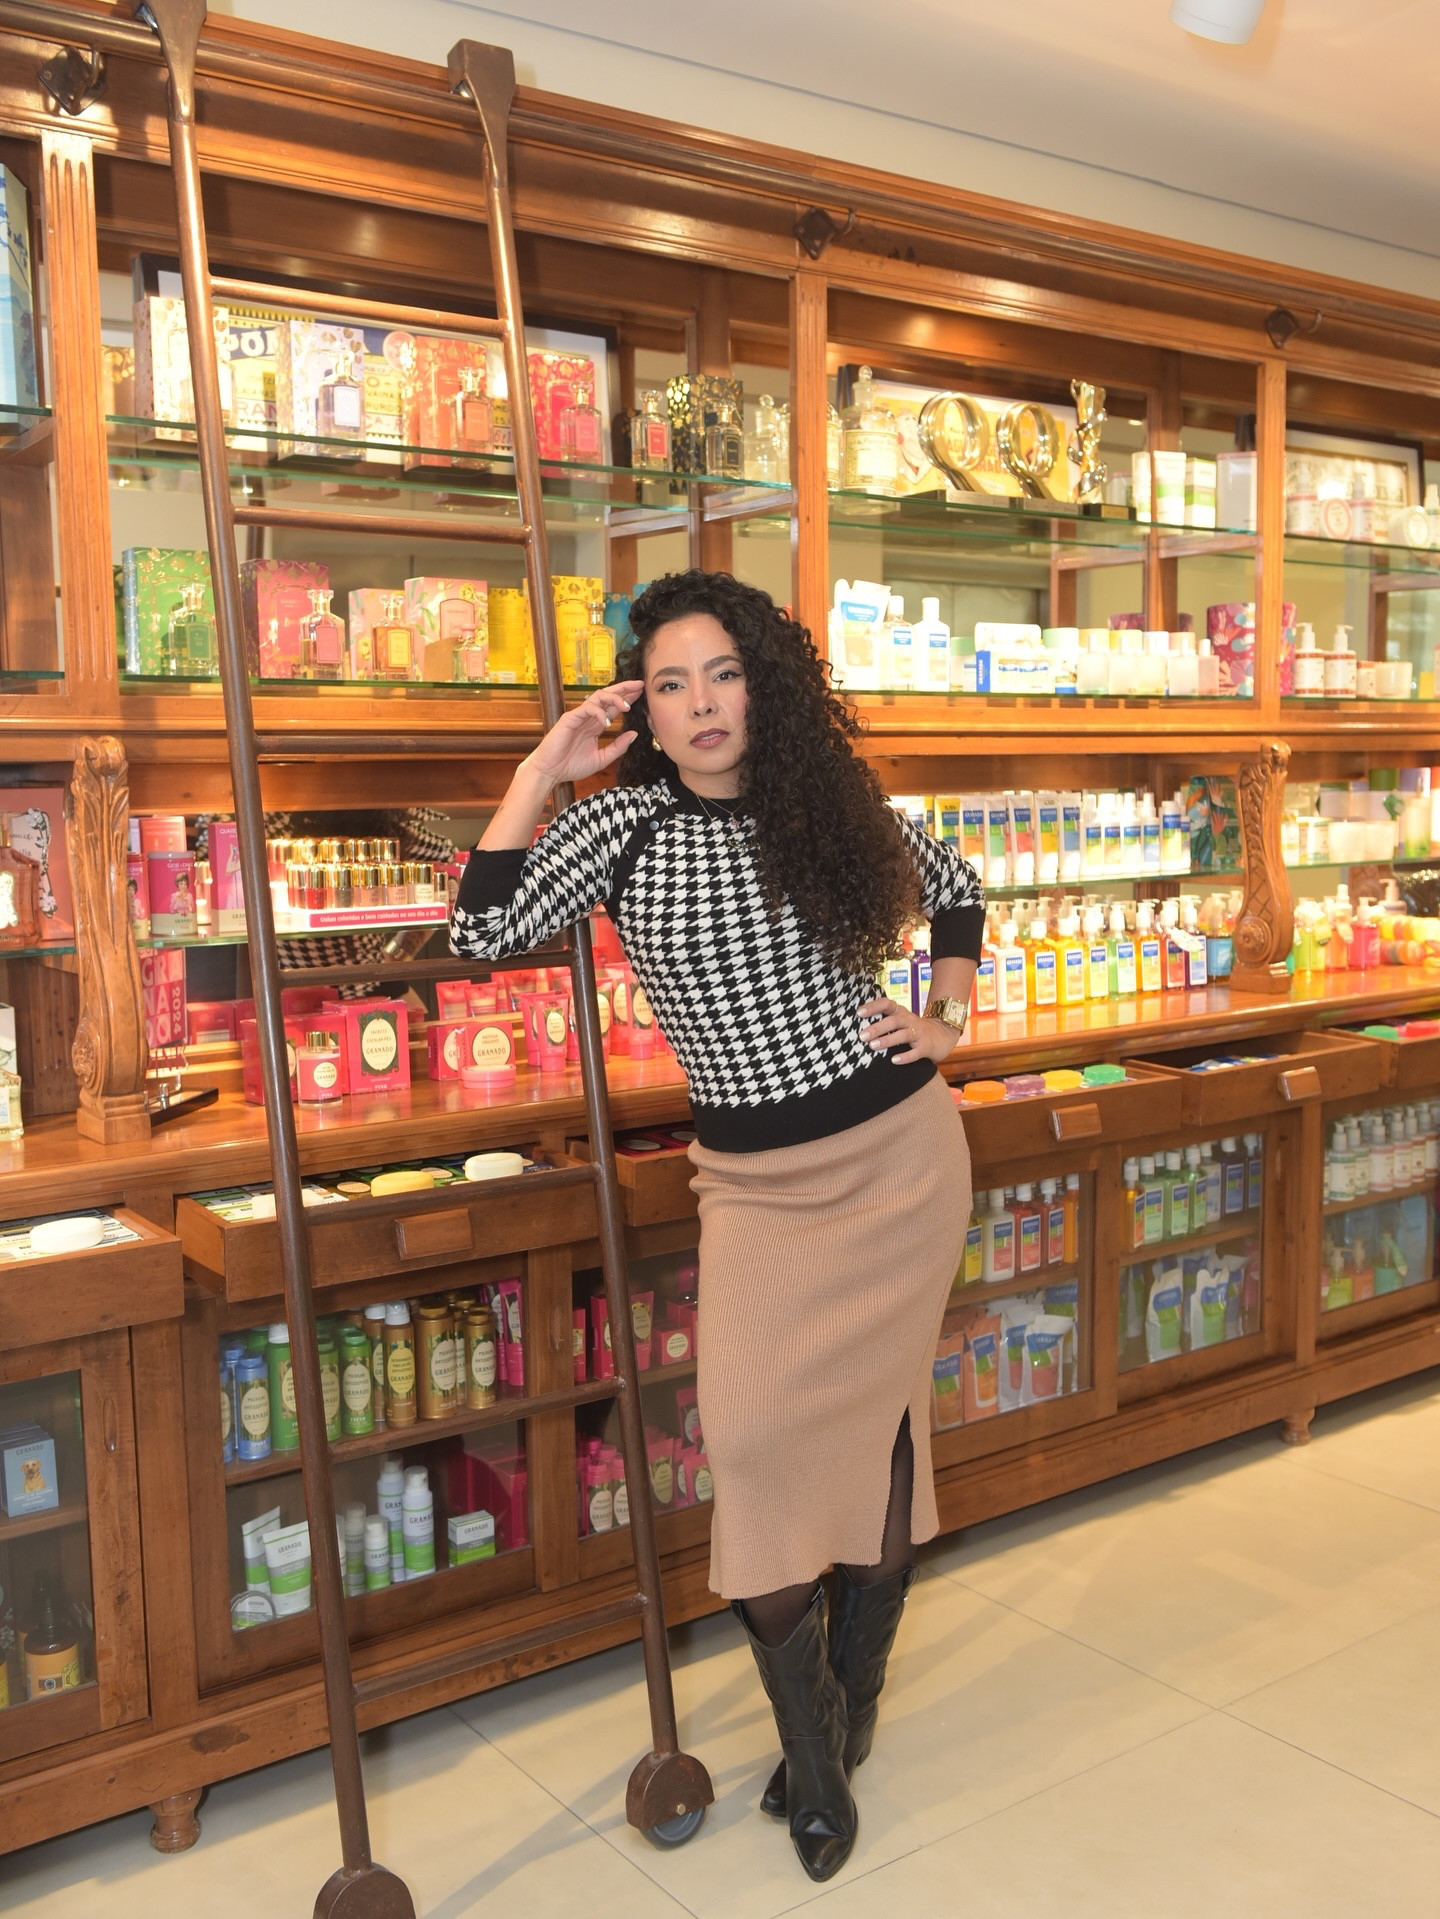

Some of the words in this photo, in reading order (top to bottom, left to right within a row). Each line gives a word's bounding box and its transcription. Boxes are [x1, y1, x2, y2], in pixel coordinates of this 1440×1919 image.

[171, 985, 182, 1036] 2024
[366, 1046, 394, 1055] GRANADO
[477, 1047, 507, 1057] GRANADO
[464, 1523, 489, 1534] GRANADO
